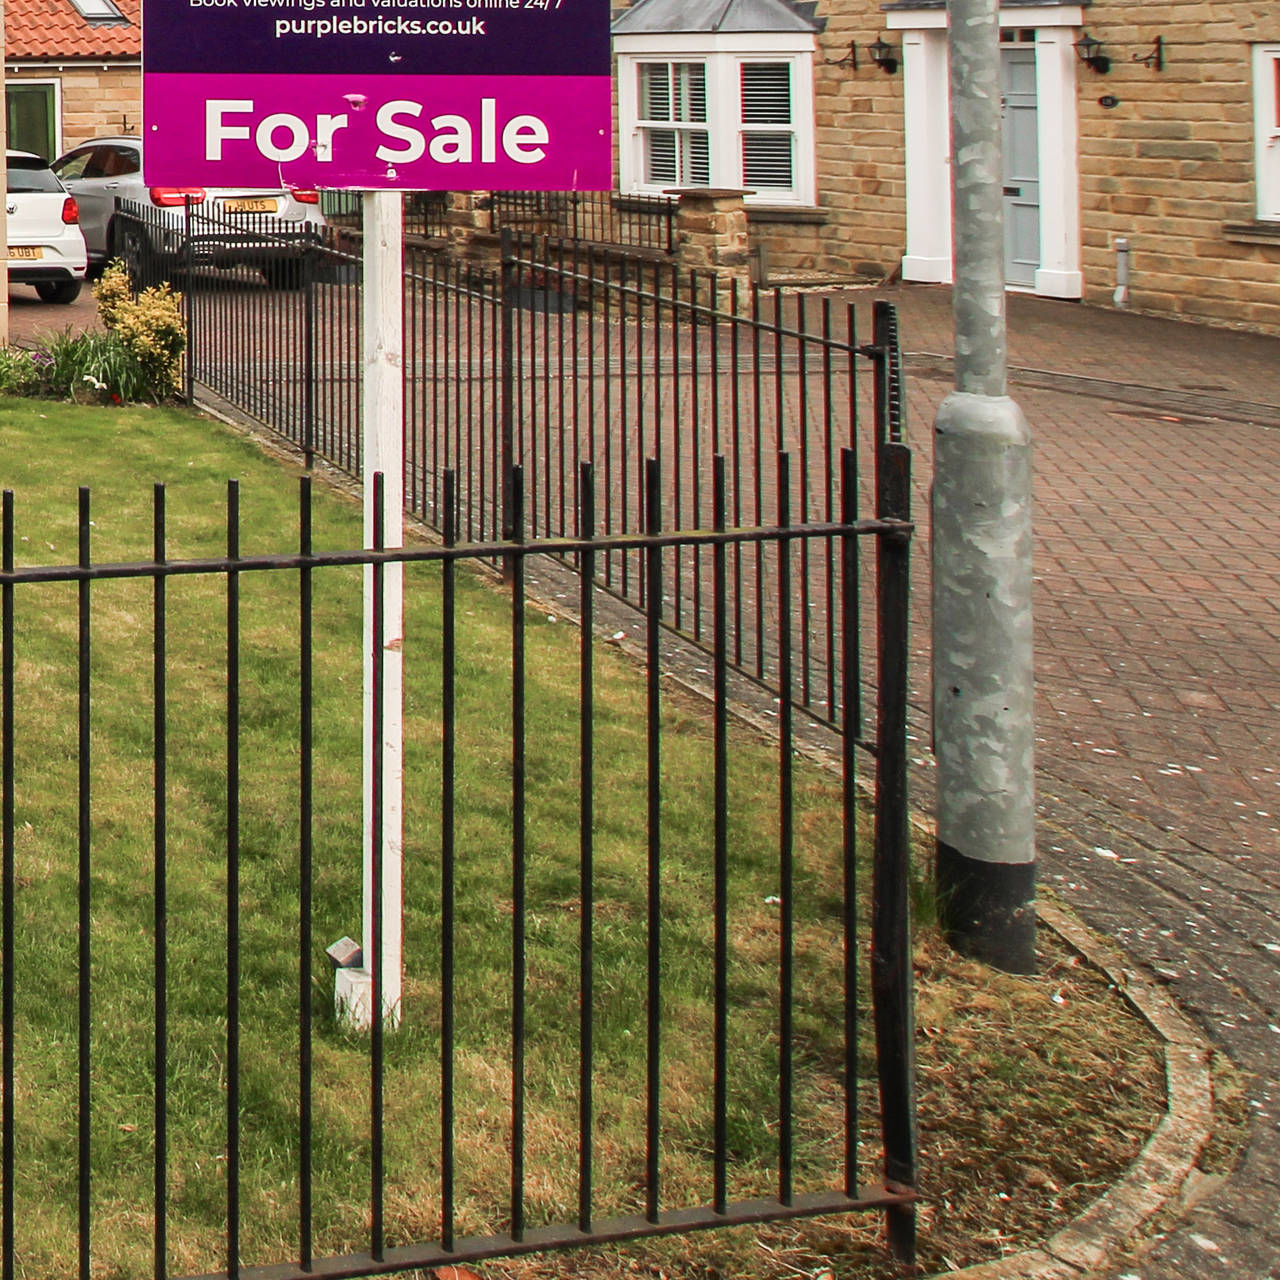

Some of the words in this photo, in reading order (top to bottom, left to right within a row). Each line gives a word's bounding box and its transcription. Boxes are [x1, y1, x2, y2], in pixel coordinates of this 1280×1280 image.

[275, 15, 487, 39] purplebricks.co.uk
[205, 99, 349, 163] For
[375, 97, 550, 165] Sale
